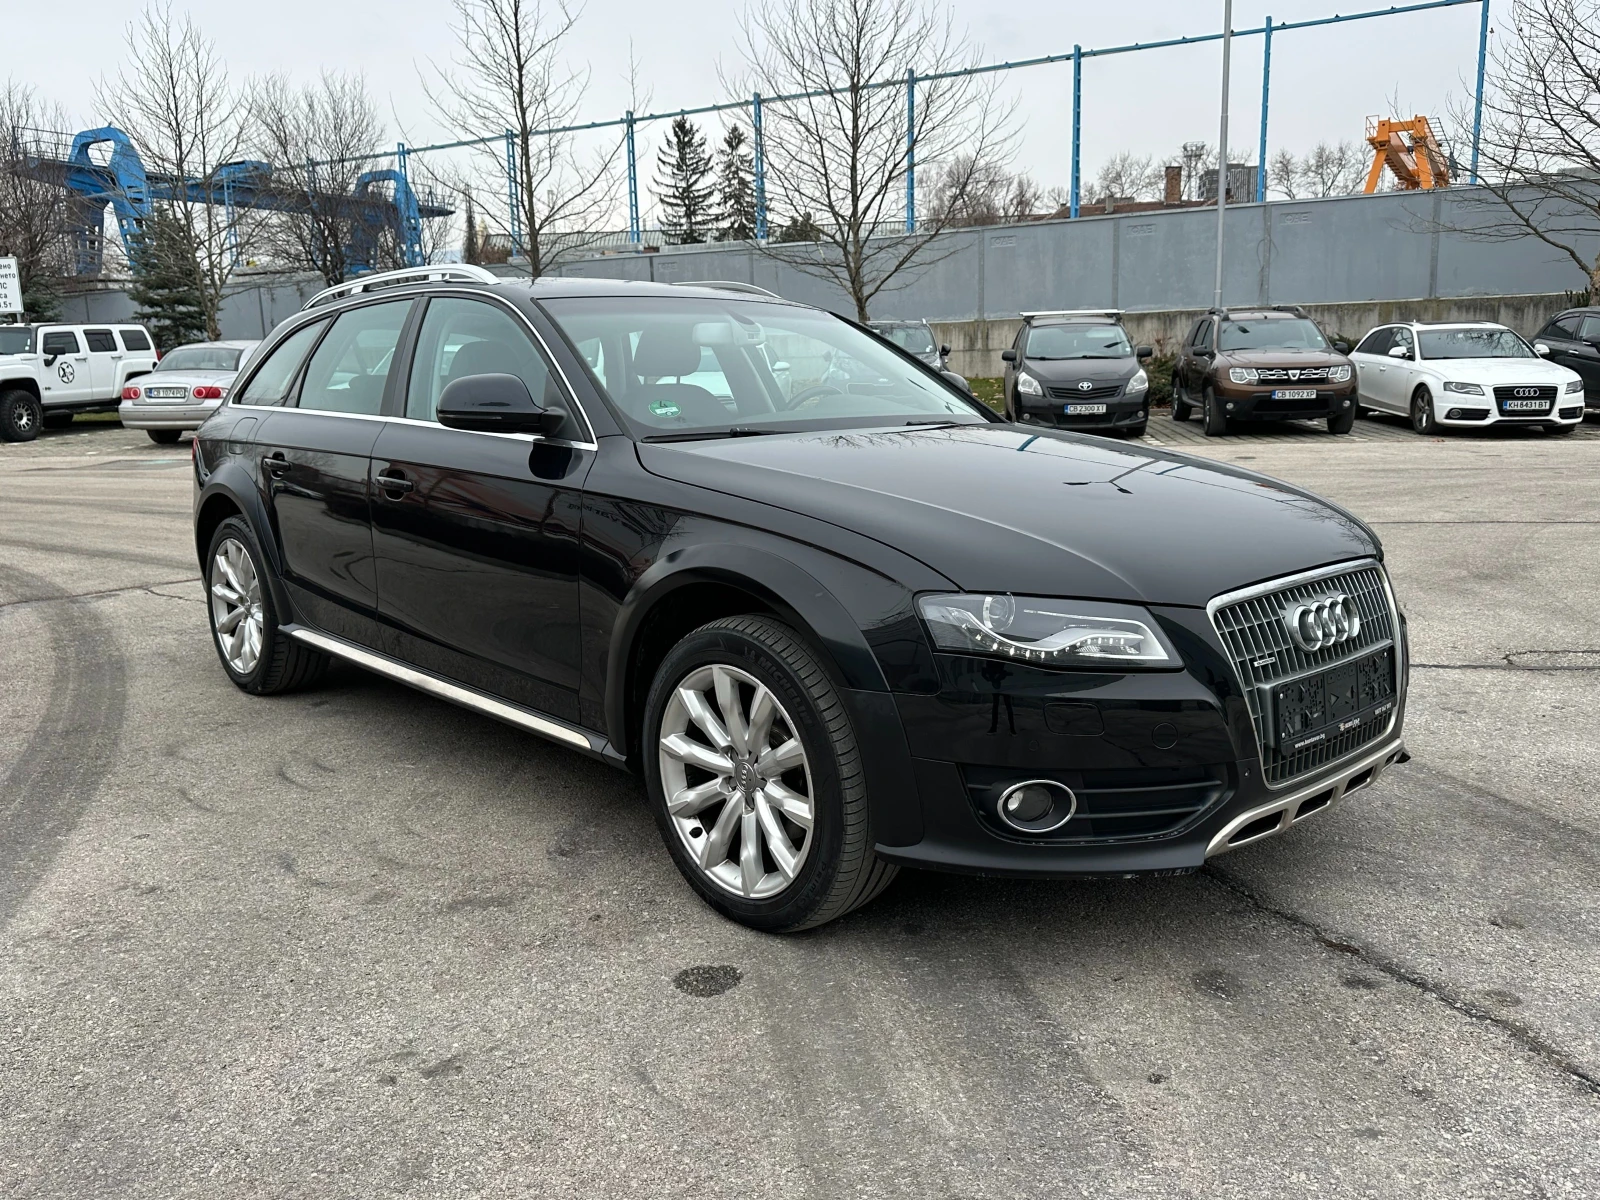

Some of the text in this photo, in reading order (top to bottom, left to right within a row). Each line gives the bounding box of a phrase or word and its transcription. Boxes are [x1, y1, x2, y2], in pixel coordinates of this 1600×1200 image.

[1276, 390, 1287, 399] CB
[1287, 390, 1305, 398] 1092
[757, 656, 816, 728] MICHELIN
